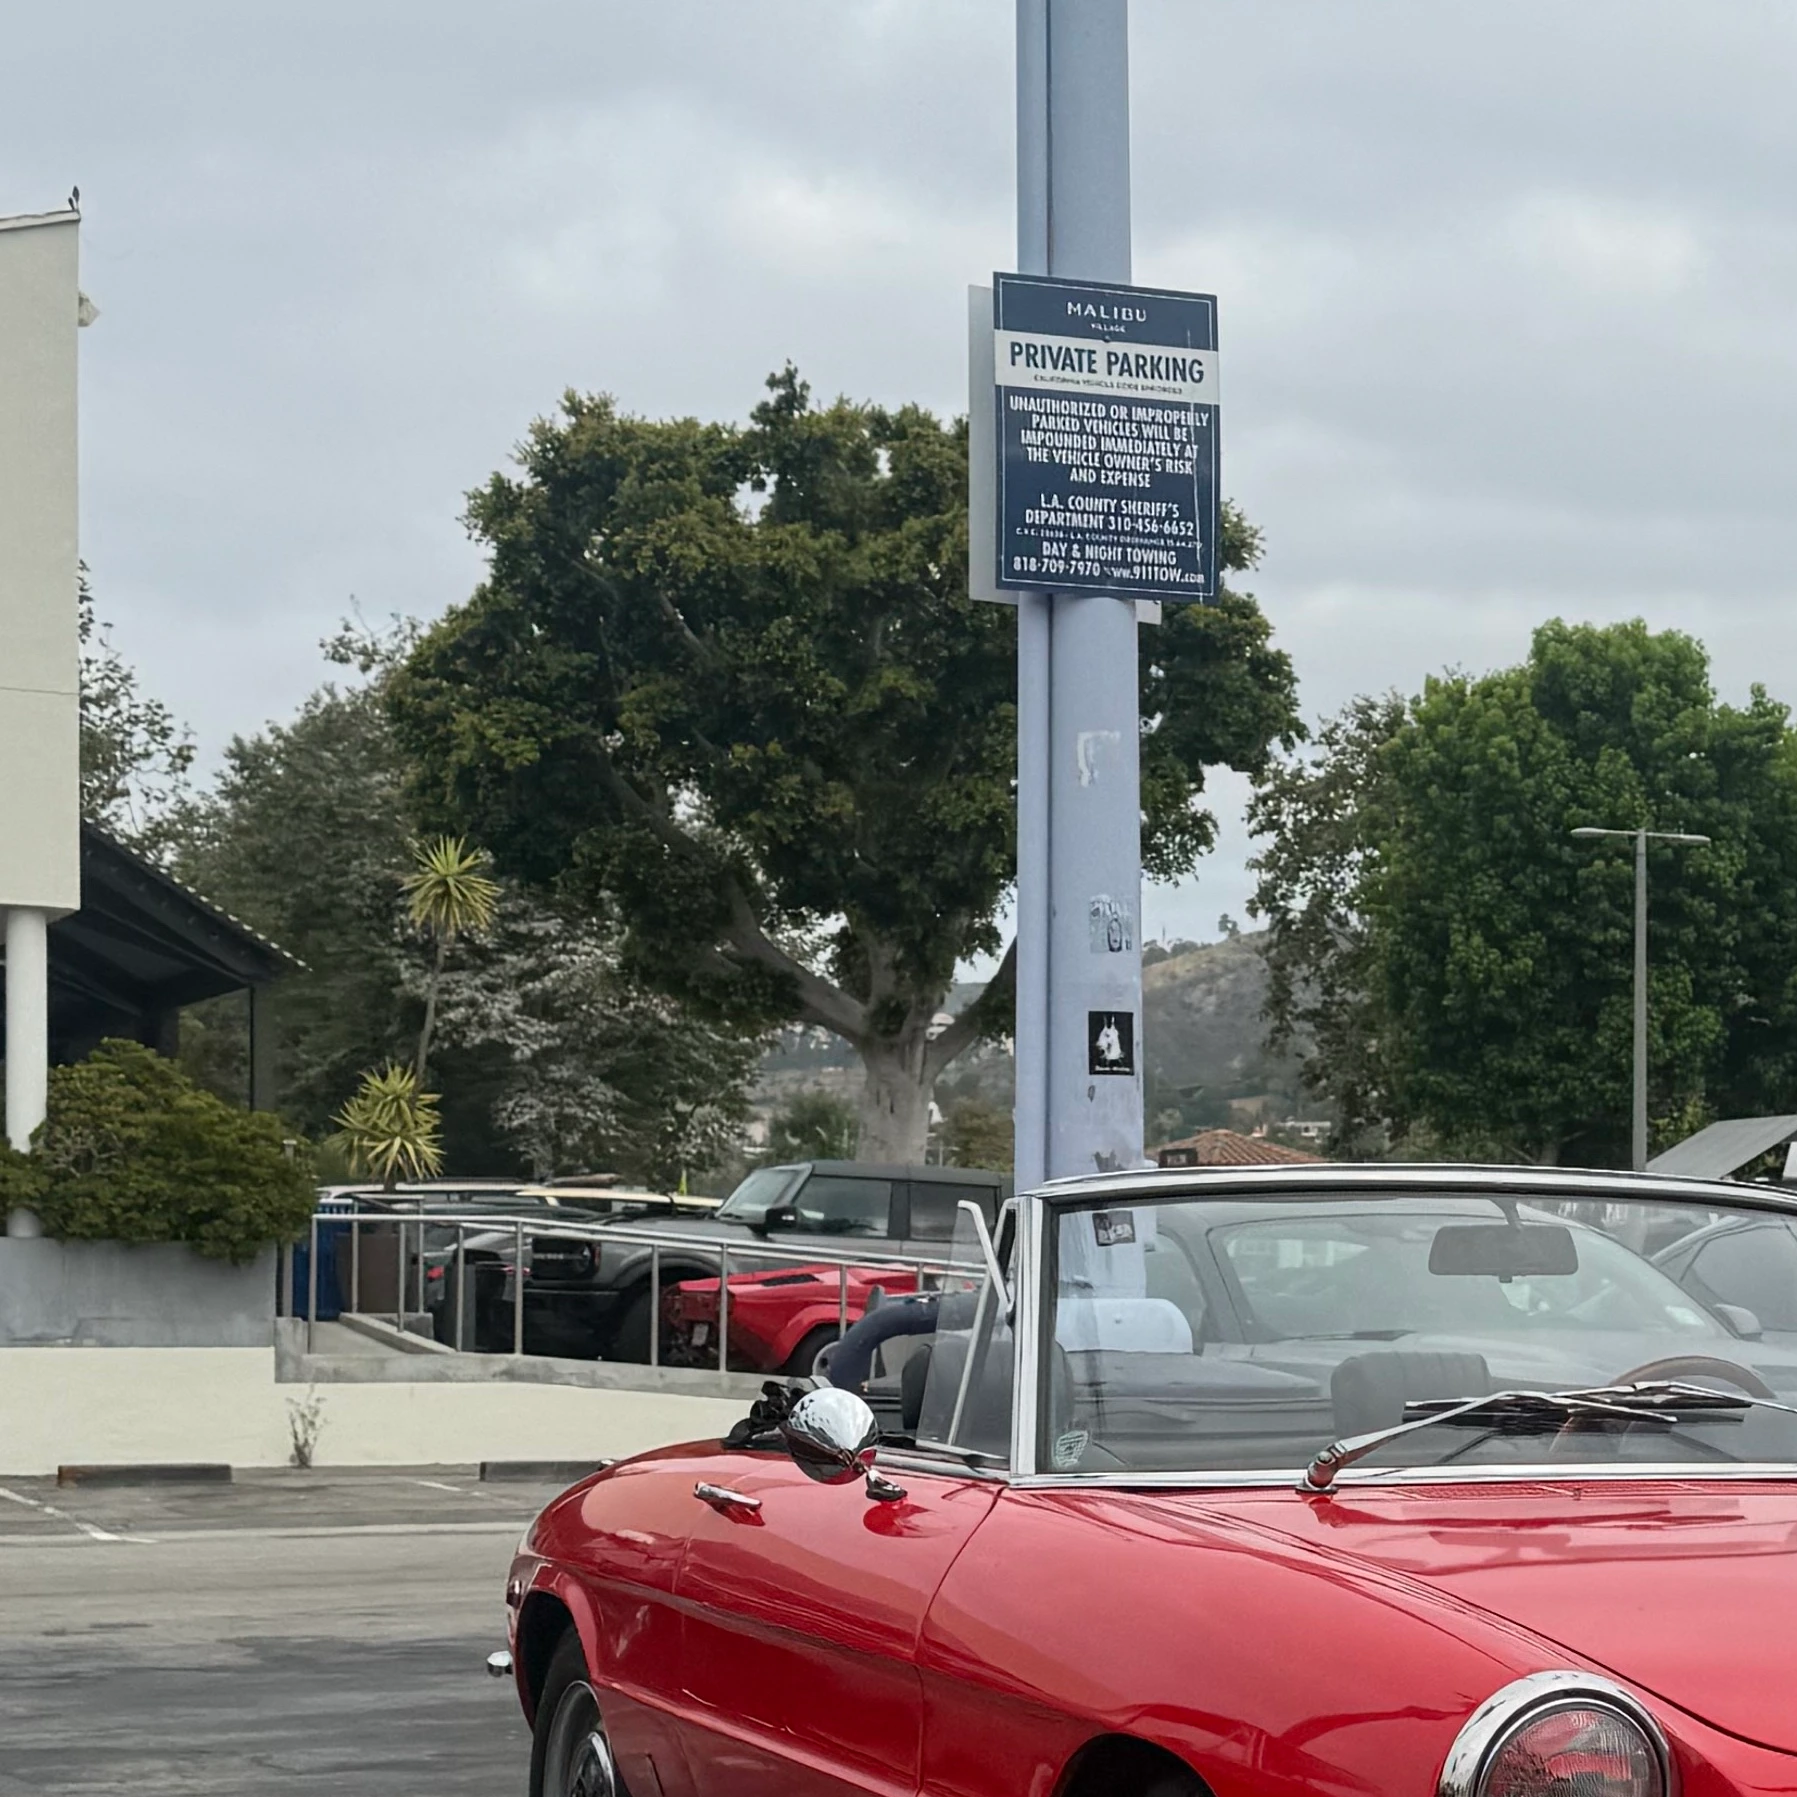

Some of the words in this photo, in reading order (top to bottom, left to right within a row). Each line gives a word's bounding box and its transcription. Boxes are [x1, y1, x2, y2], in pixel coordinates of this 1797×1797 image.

[1067, 301, 1147, 322] MALIBU
[1010, 341, 1098, 374] PRIVATE
[1107, 351, 1204, 384] PARKING
[1009, 395, 1105, 419] UNAUTHORIZED
[1110, 404, 1128, 420] OR
[1132, 406, 1210, 427] IMPROPERLY
[1032, 414, 1080, 432] PARKED
[1084, 419, 1138, 438] VEHICLES
[1141, 424, 1171, 441] WILL
[1174, 427, 1188, 442] BE
[1021, 429, 1097, 451] IMPOUNDED
[1101, 436, 1181, 458] IMMEDIATELY
[1184, 444, 1198, 459] AT
[1026, 446, 1049, 463] THE
[1052, 449, 1100, 468] VEHICLE
[1104, 453, 1162, 473] OWNER'S
[1165, 459, 1193, 475] RISK
[1069, 468, 1097, 484] AND
[1101, 470, 1151, 488] EXPENSE
[1040, 493, 1064, 509] L.A.
[1068, 496, 1117, 514] COUNTY
[1121, 500, 1179, 518] SHERIFF'S
[1025, 509, 1104, 530] DEPARTMENT
[1107, 516, 1194, 537] 310-456-6652
[1013, 556, 1101, 577] 818-709-7970
[1042, 541, 1068, 558] DAY
[1072, 543, 1081, 559] &
[1085, 544, 1122, 562] NIGHT
[1126, 548, 1177, 566] TOWING
